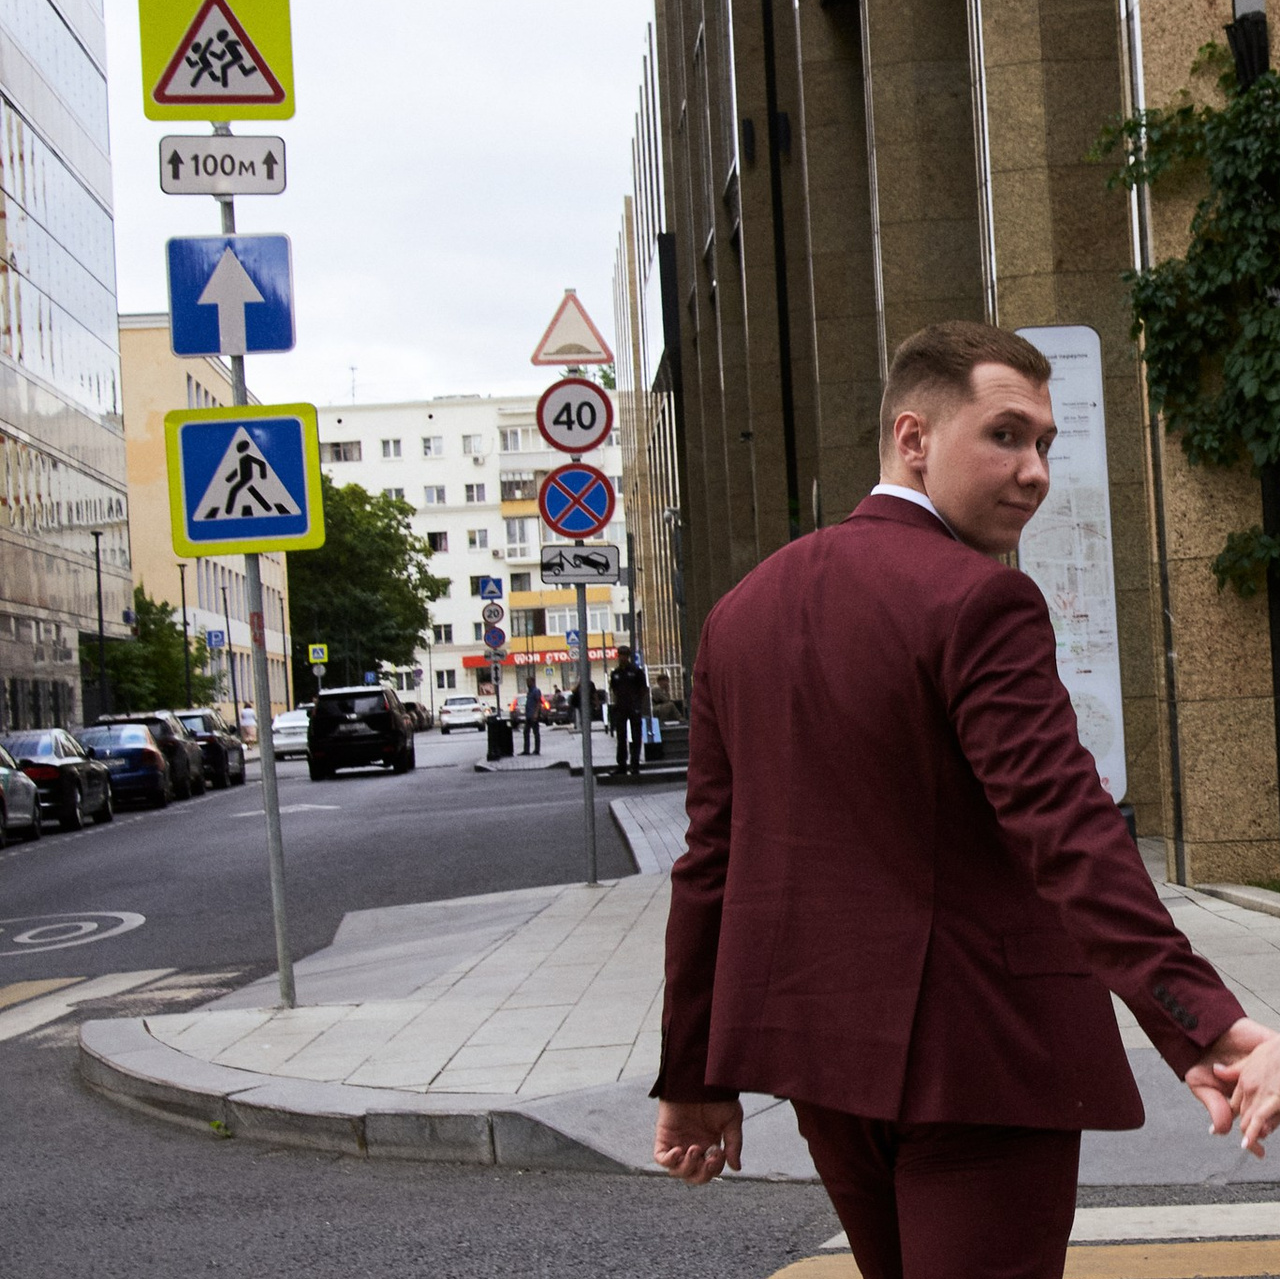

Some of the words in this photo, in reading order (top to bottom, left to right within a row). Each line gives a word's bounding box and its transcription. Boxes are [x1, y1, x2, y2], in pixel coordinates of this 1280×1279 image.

[190, 153, 256, 177] 100м
[552, 400, 597, 431] 40
[486, 608, 500, 619] 20
[211, 632, 222, 647] P
[0, 921, 98, 944] 0
